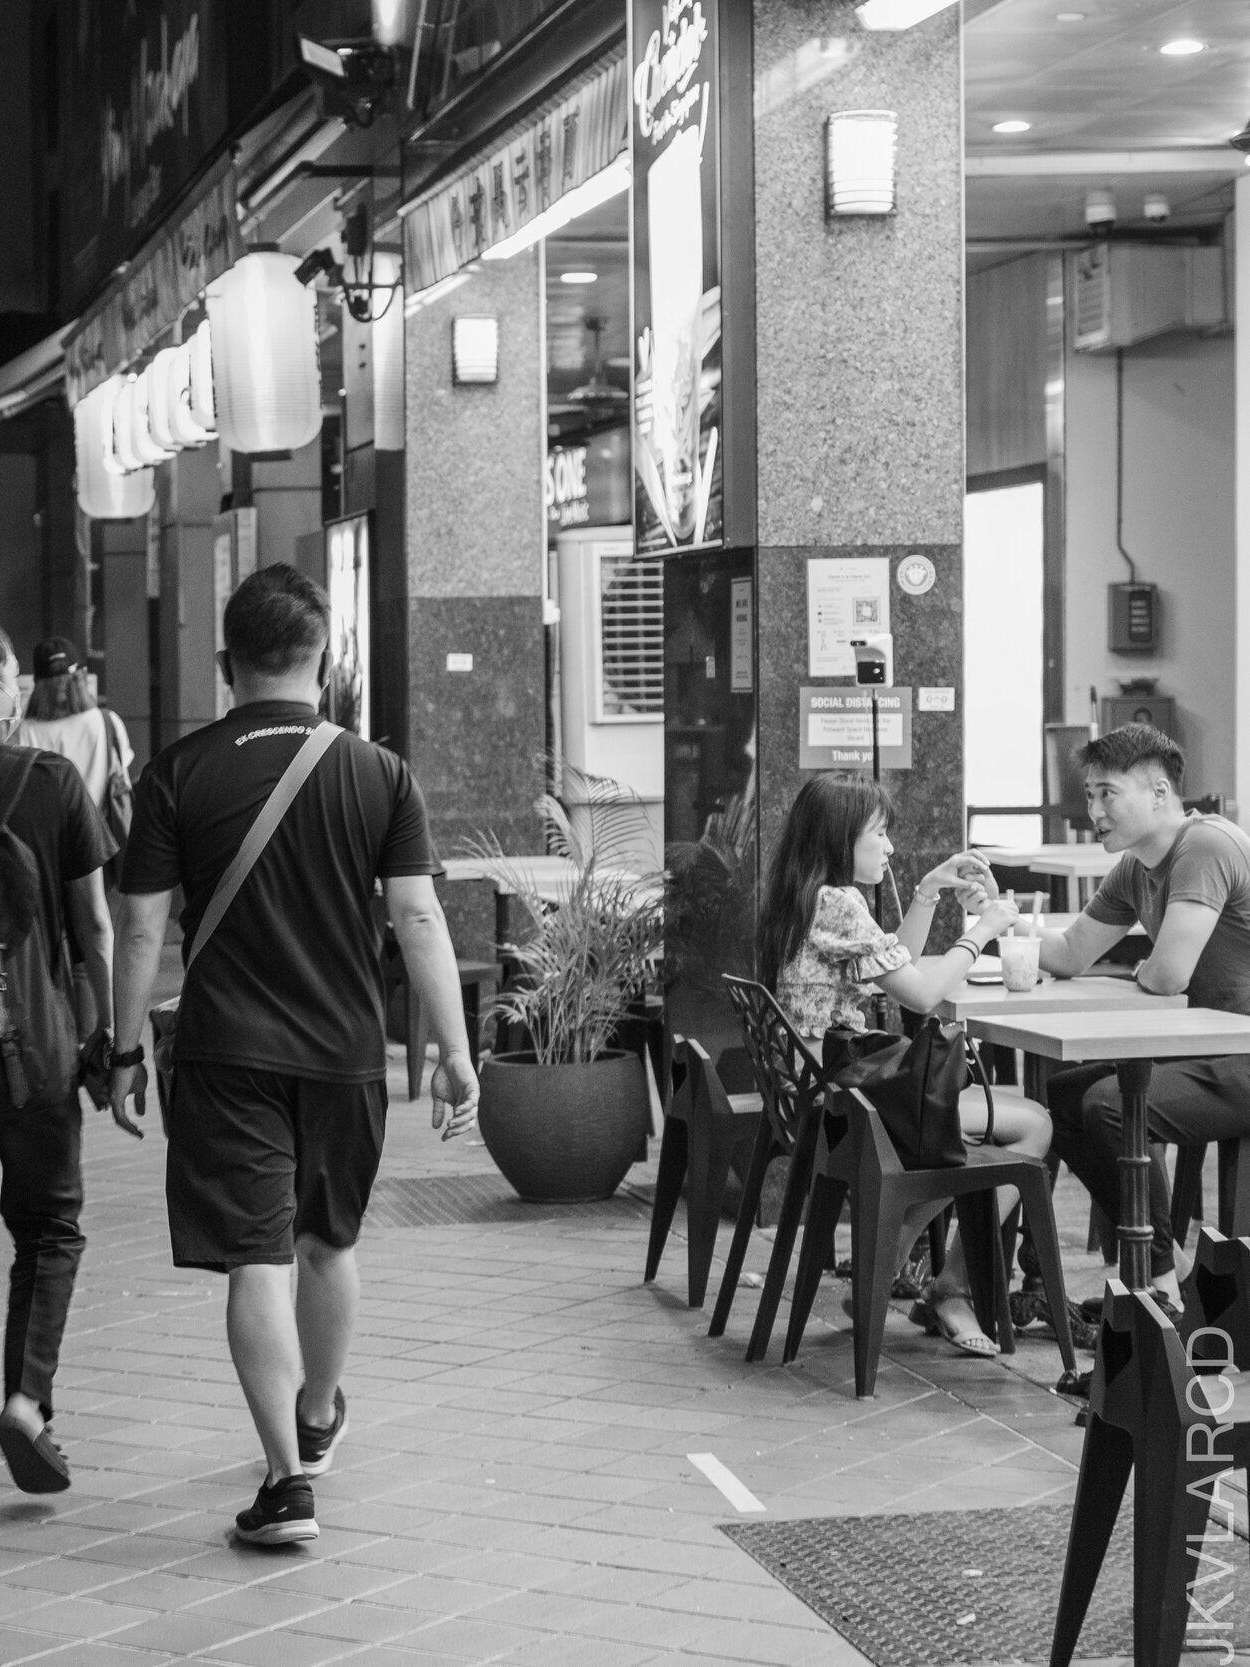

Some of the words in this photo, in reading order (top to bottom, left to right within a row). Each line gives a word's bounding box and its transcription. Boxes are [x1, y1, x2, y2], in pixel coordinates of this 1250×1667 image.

[811, 697, 844, 708] SOCIAL
[846, 697, 900, 708] DISTACING
[832, 750, 860, 761] Thank
